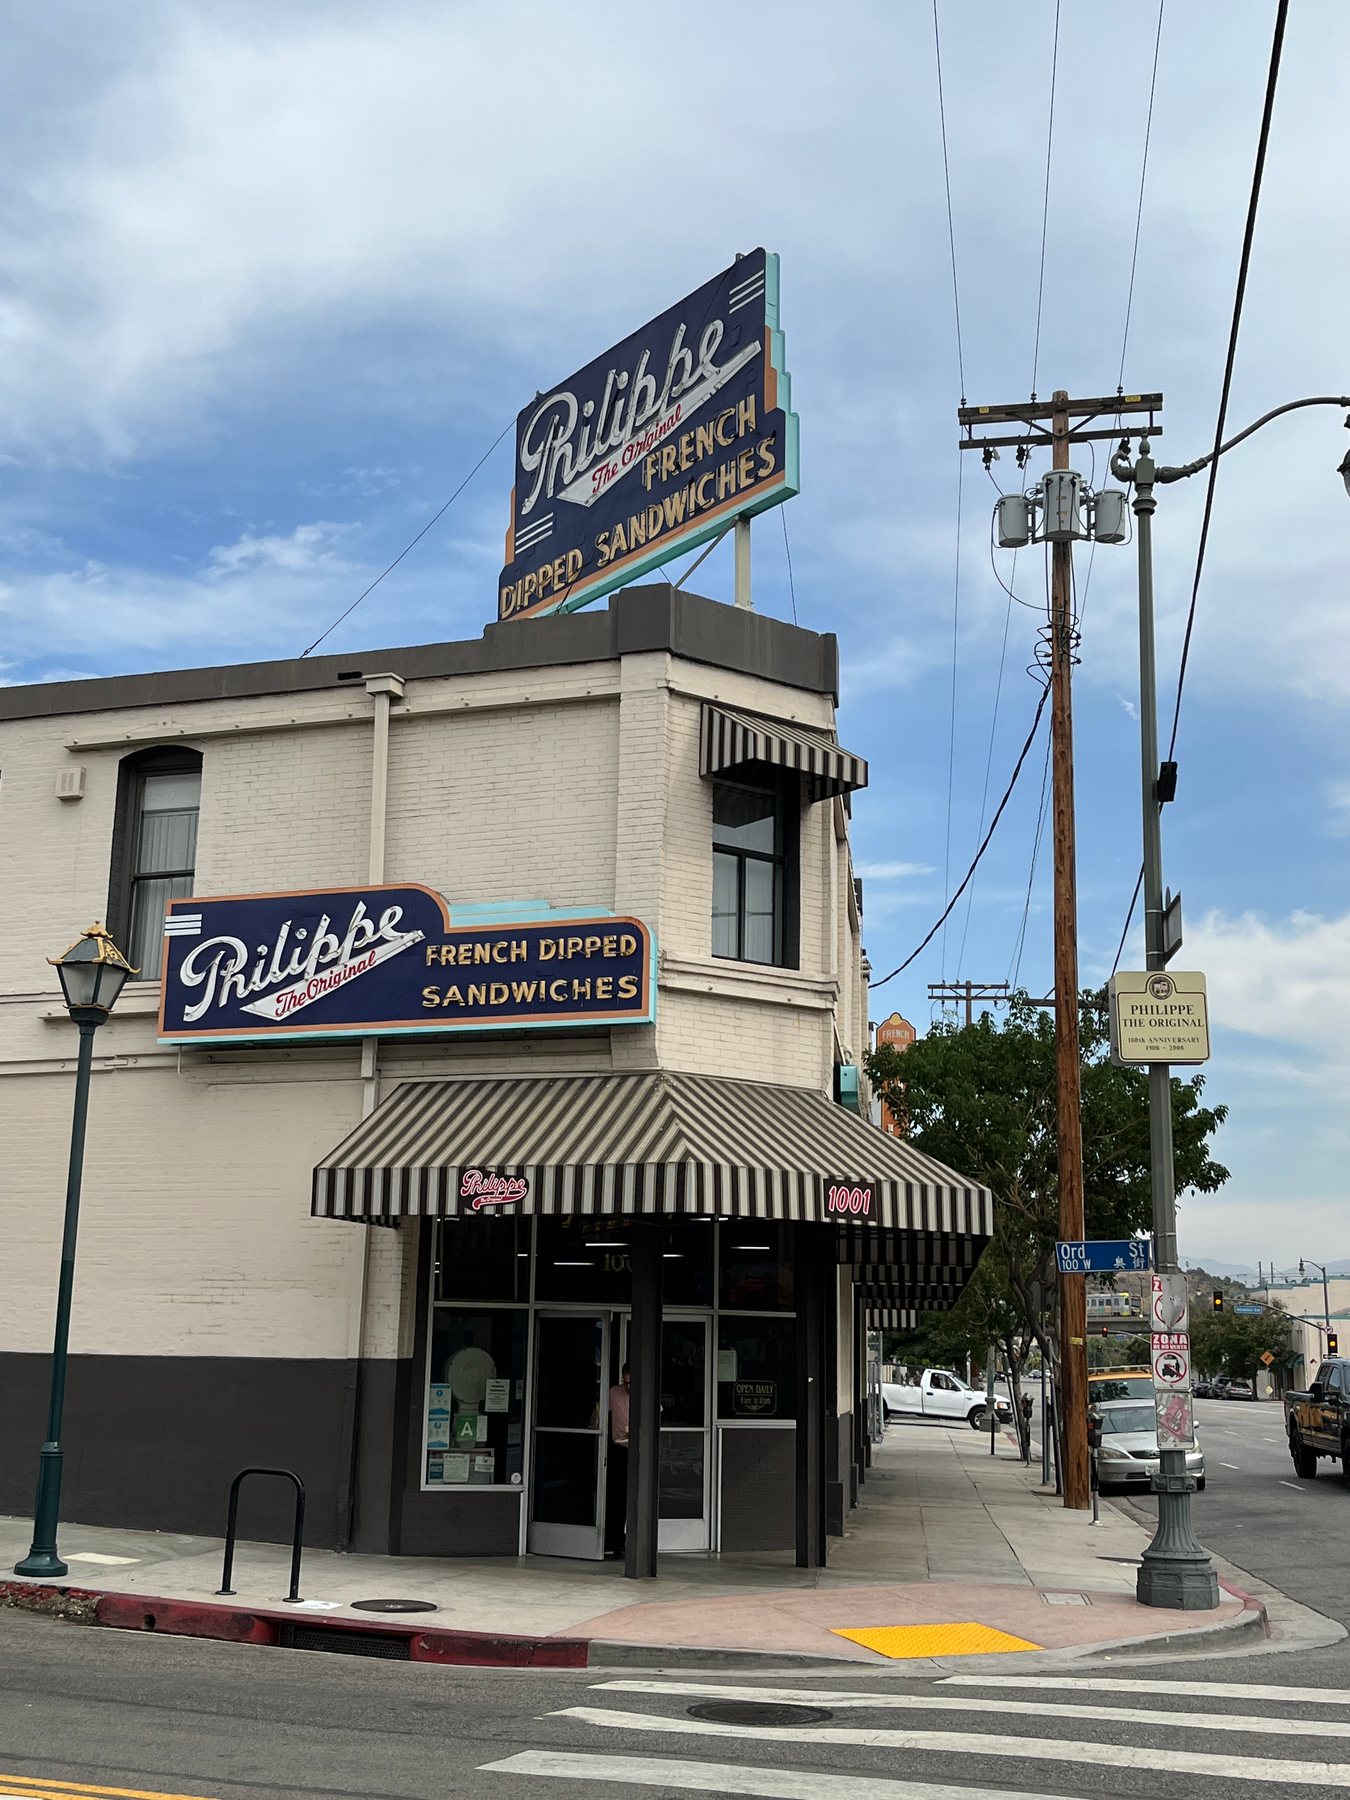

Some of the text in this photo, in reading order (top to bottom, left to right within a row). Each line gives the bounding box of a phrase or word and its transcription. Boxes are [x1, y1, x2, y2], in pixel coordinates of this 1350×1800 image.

[520, 319, 725, 515] Philippe
[591, 403, 683, 494] The Original
[642, 394, 757, 492] FRENCH
[500, 431, 777, 619] DIPPED SANDWICHES
[179, 899, 411, 1023] Philippe
[425, 933, 638, 967] FRENCH DIPPED
[275, 950, 377, 1017] The Original
[421, 975, 639, 1008] SANDWICHES
[1122, 1018, 1205, 1028] THE ORIGINAL
[1130, 1004, 1195, 1015] PHILIPPE
[883, 1028, 910, 1041] FRENCH
[460, 1169, 527, 1197] Philippe
[828, 1185, 871, 1215] 1001
[1061, 1242, 1145, 1260] Ord St
[1062, 1259, 1091, 1271] 100 W
[1153, 1334, 1188, 1345] ZONA
[736, 1384, 774, 1394] OPEN DAILY
[460, 1421, 474, 1437] A
